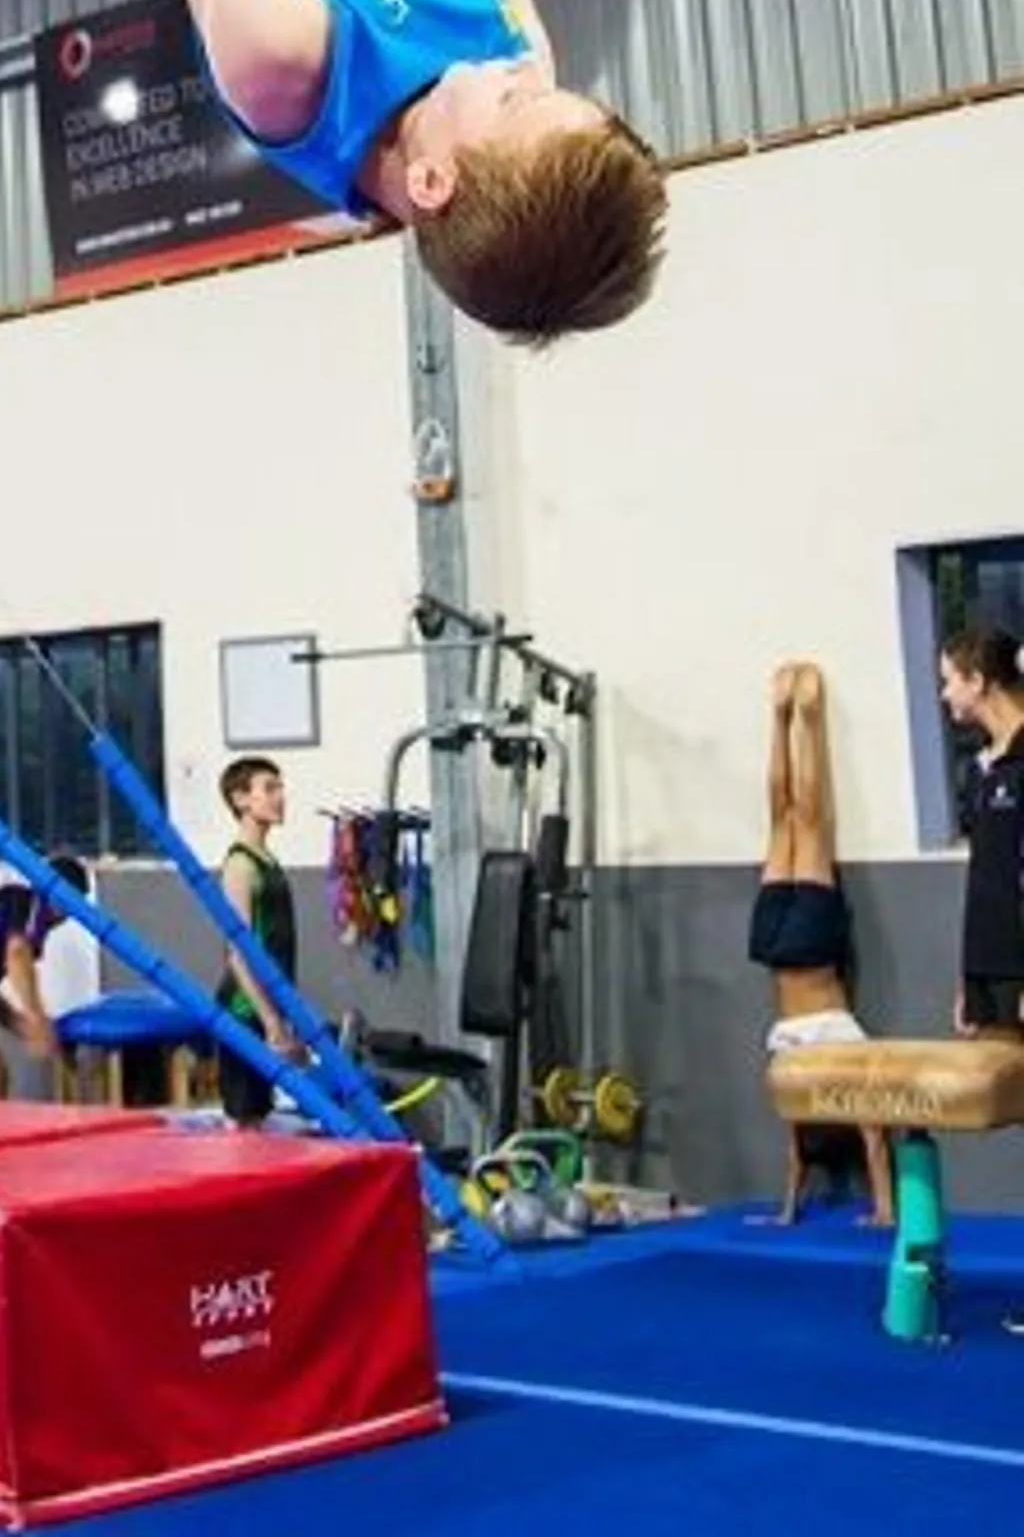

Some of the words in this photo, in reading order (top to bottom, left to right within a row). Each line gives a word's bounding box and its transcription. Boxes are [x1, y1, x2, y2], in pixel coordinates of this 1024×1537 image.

[63, 84, 175, 137] COMTED
[136, 147, 207, 191] DESIGN
[189, 1269, 274, 1312] HART
